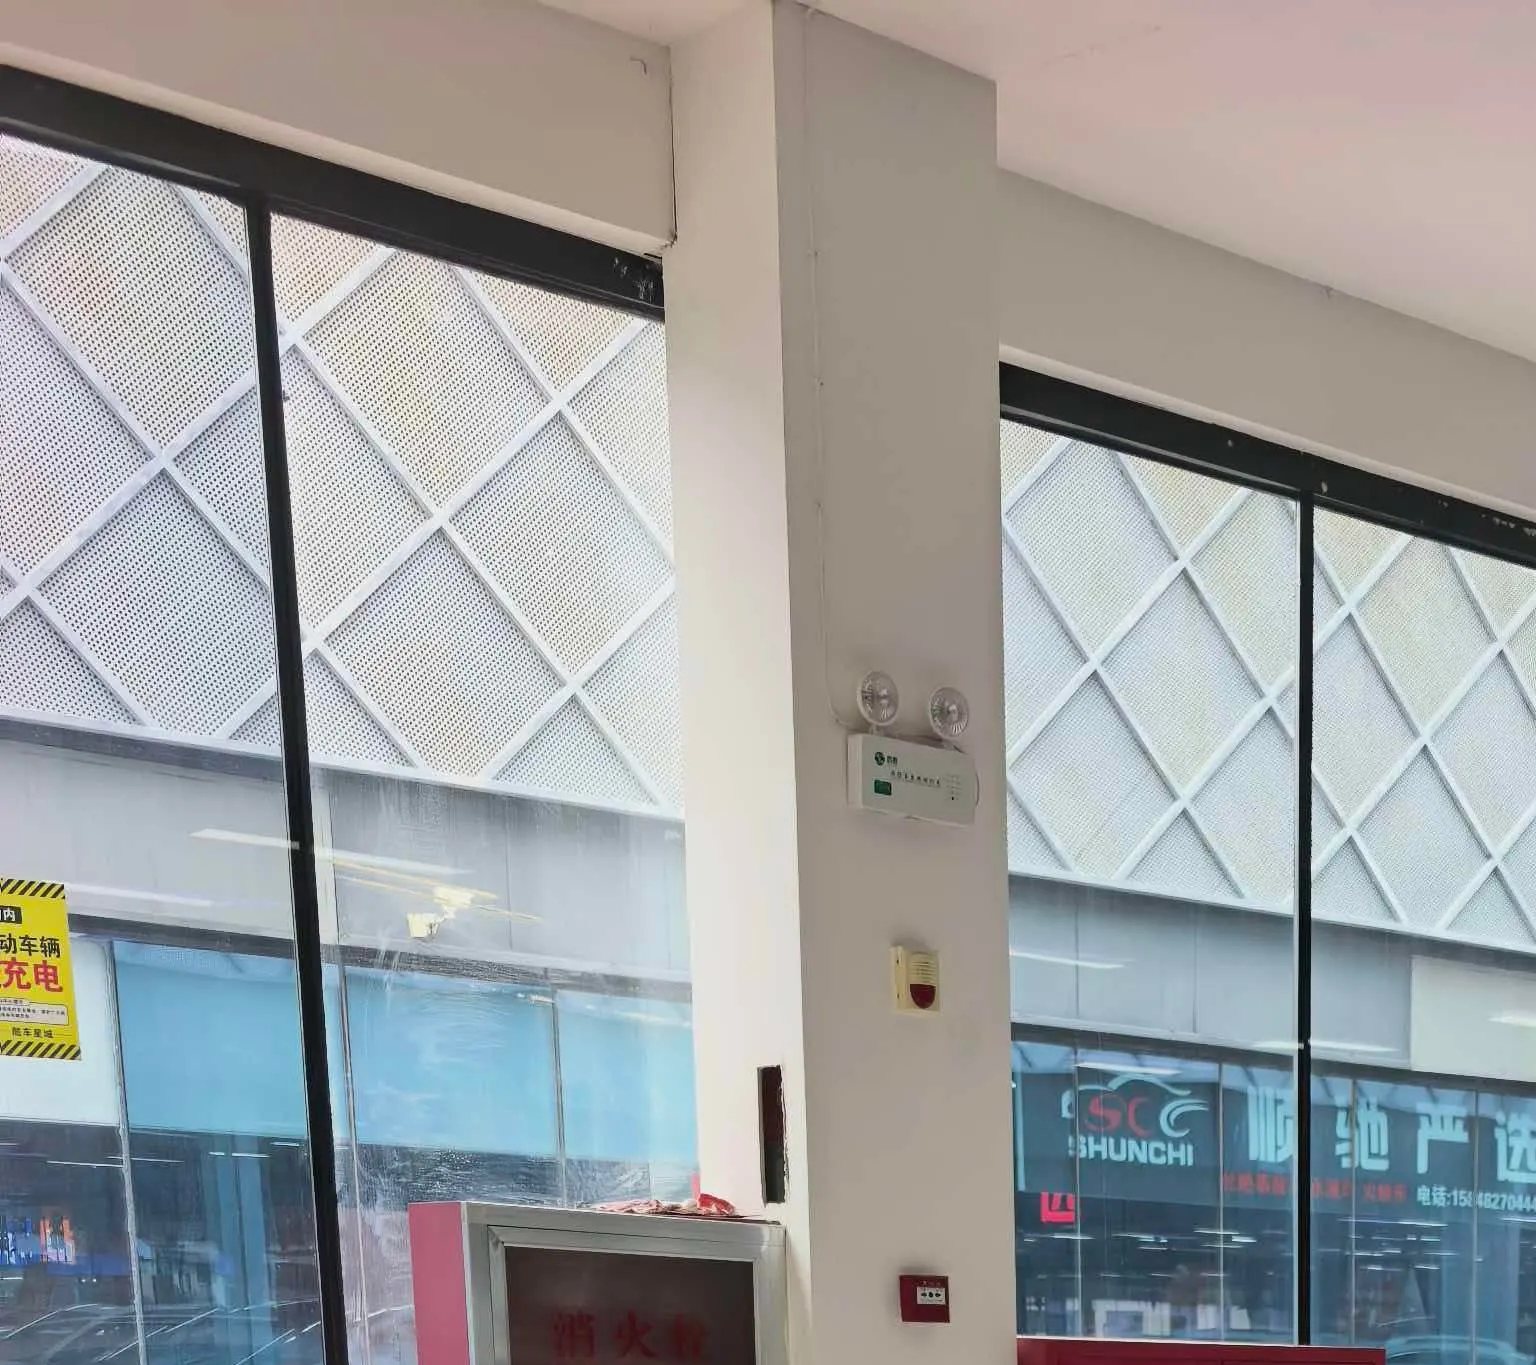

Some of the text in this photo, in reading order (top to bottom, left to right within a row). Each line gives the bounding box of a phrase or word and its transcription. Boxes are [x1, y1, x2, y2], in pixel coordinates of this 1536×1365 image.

[0, 933, 61, 958] 动车辆
[0, 957, 63, 993] 充电
[1068, 1136, 1194, 1167] SHUNCHI
